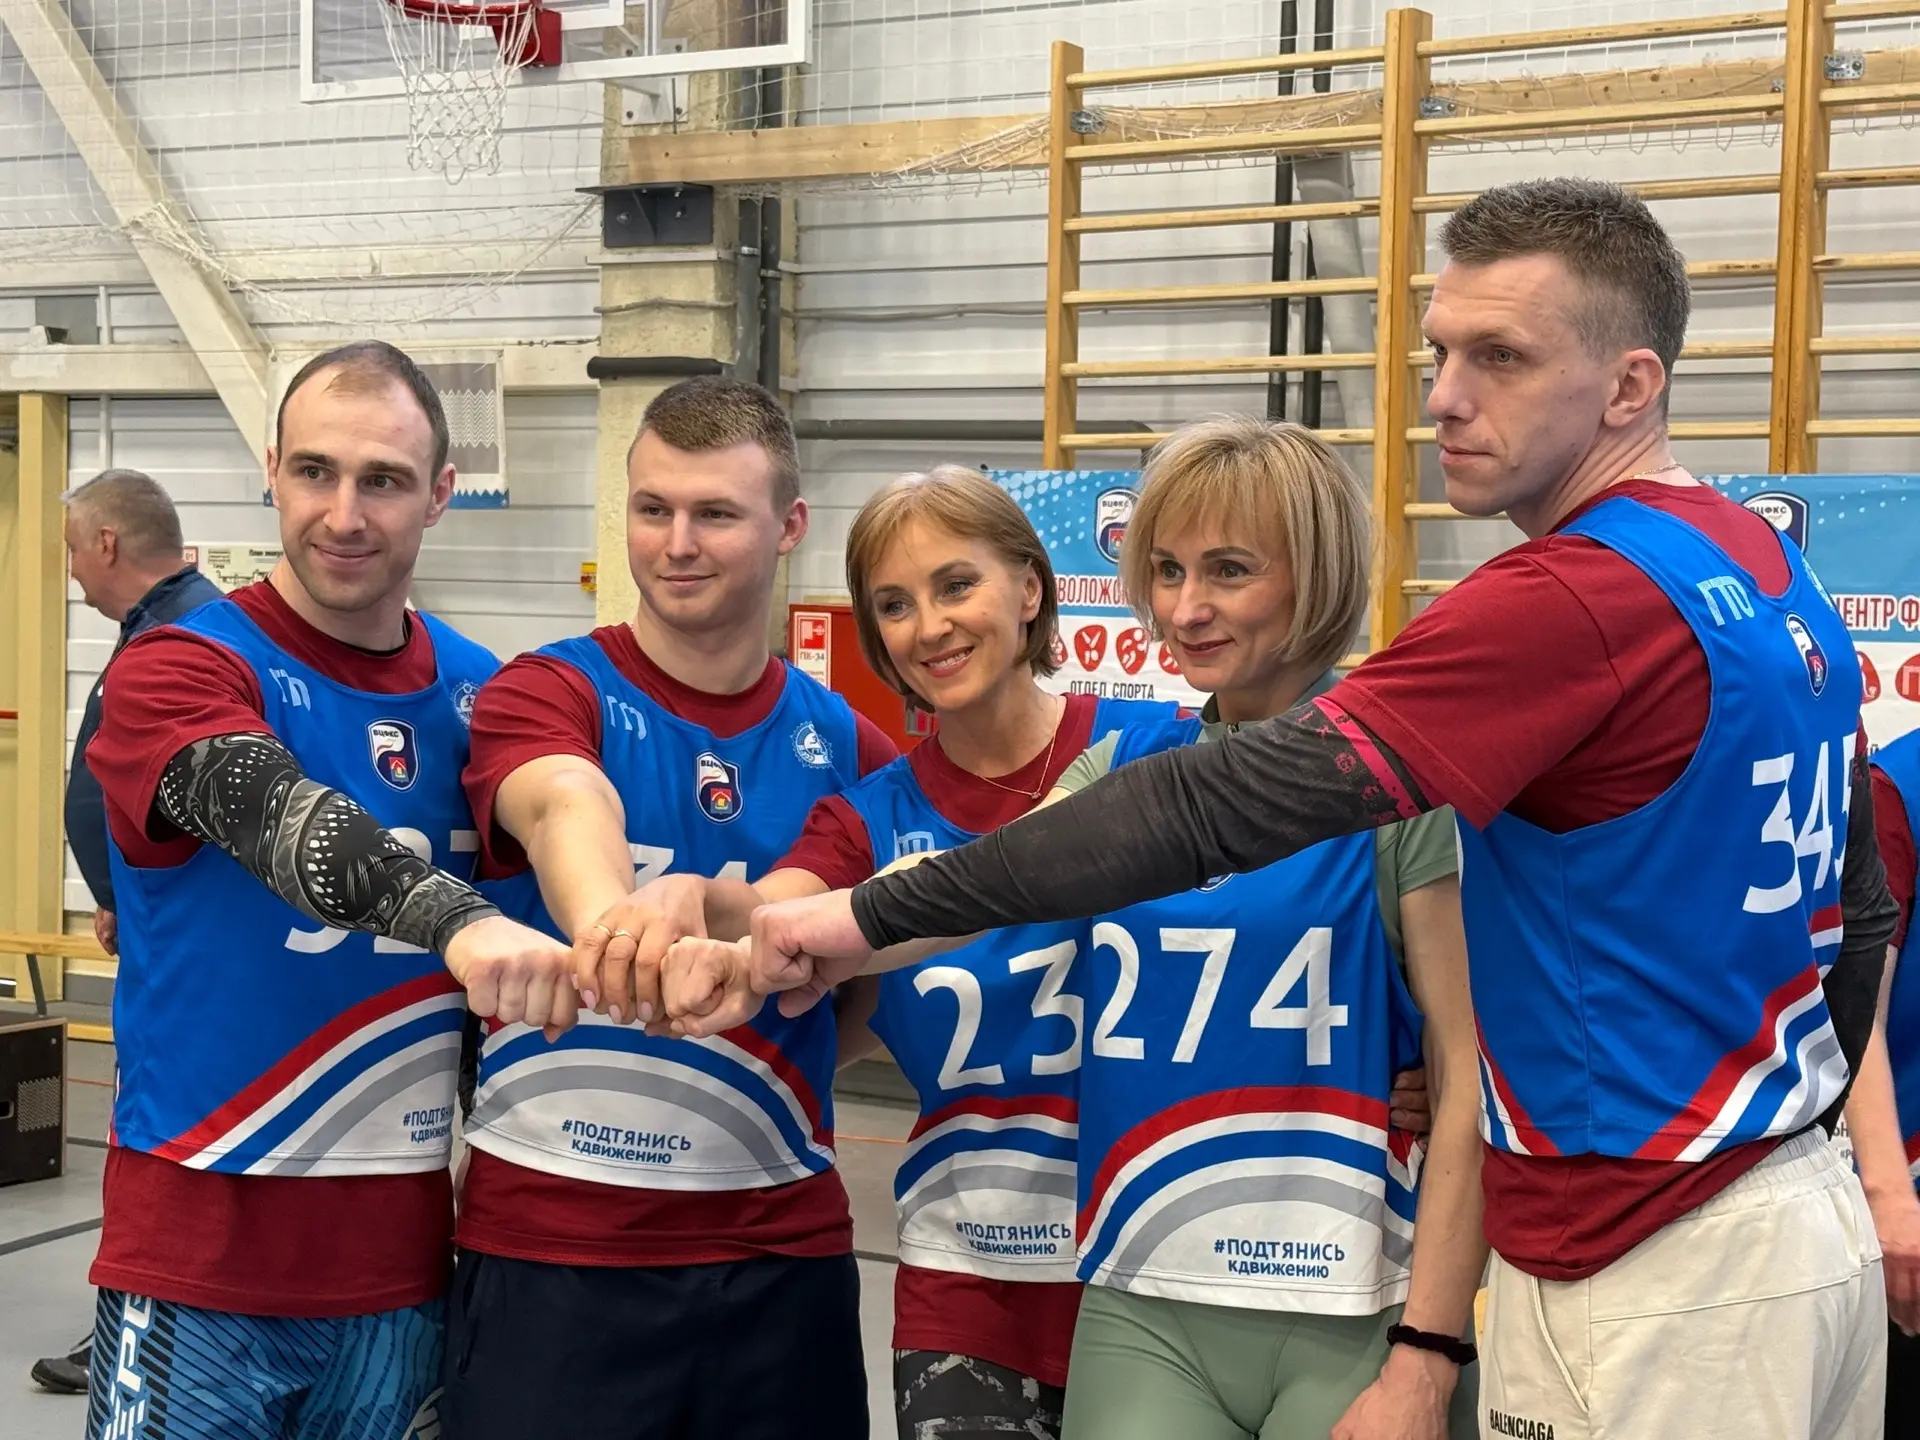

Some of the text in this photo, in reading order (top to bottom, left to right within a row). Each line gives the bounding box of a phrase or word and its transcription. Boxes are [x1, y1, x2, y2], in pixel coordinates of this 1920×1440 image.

[1055, 577, 1128, 605] ВОЛОЖС
[1836, 597, 1895, 628] ЕНТР
[1070, 680, 1155, 700] ОТДЕЛ СПОРТА
[373, 728, 400, 739] ВЦФКС
[1092, 921, 1349, 1067] 274
[561, 1119, 692, 1151] #ПОДТЯНИСЬ
[956, 1221, 1072, 1242] #ПОДТЯНИСЬ
[1213, 1238, 1346, 1262] #ПОДТЯНИСЬ
[1228, 1259, 1330, 1279] кдвижению
[1489, 1408, 1555, 1440] BALENCIAGA
